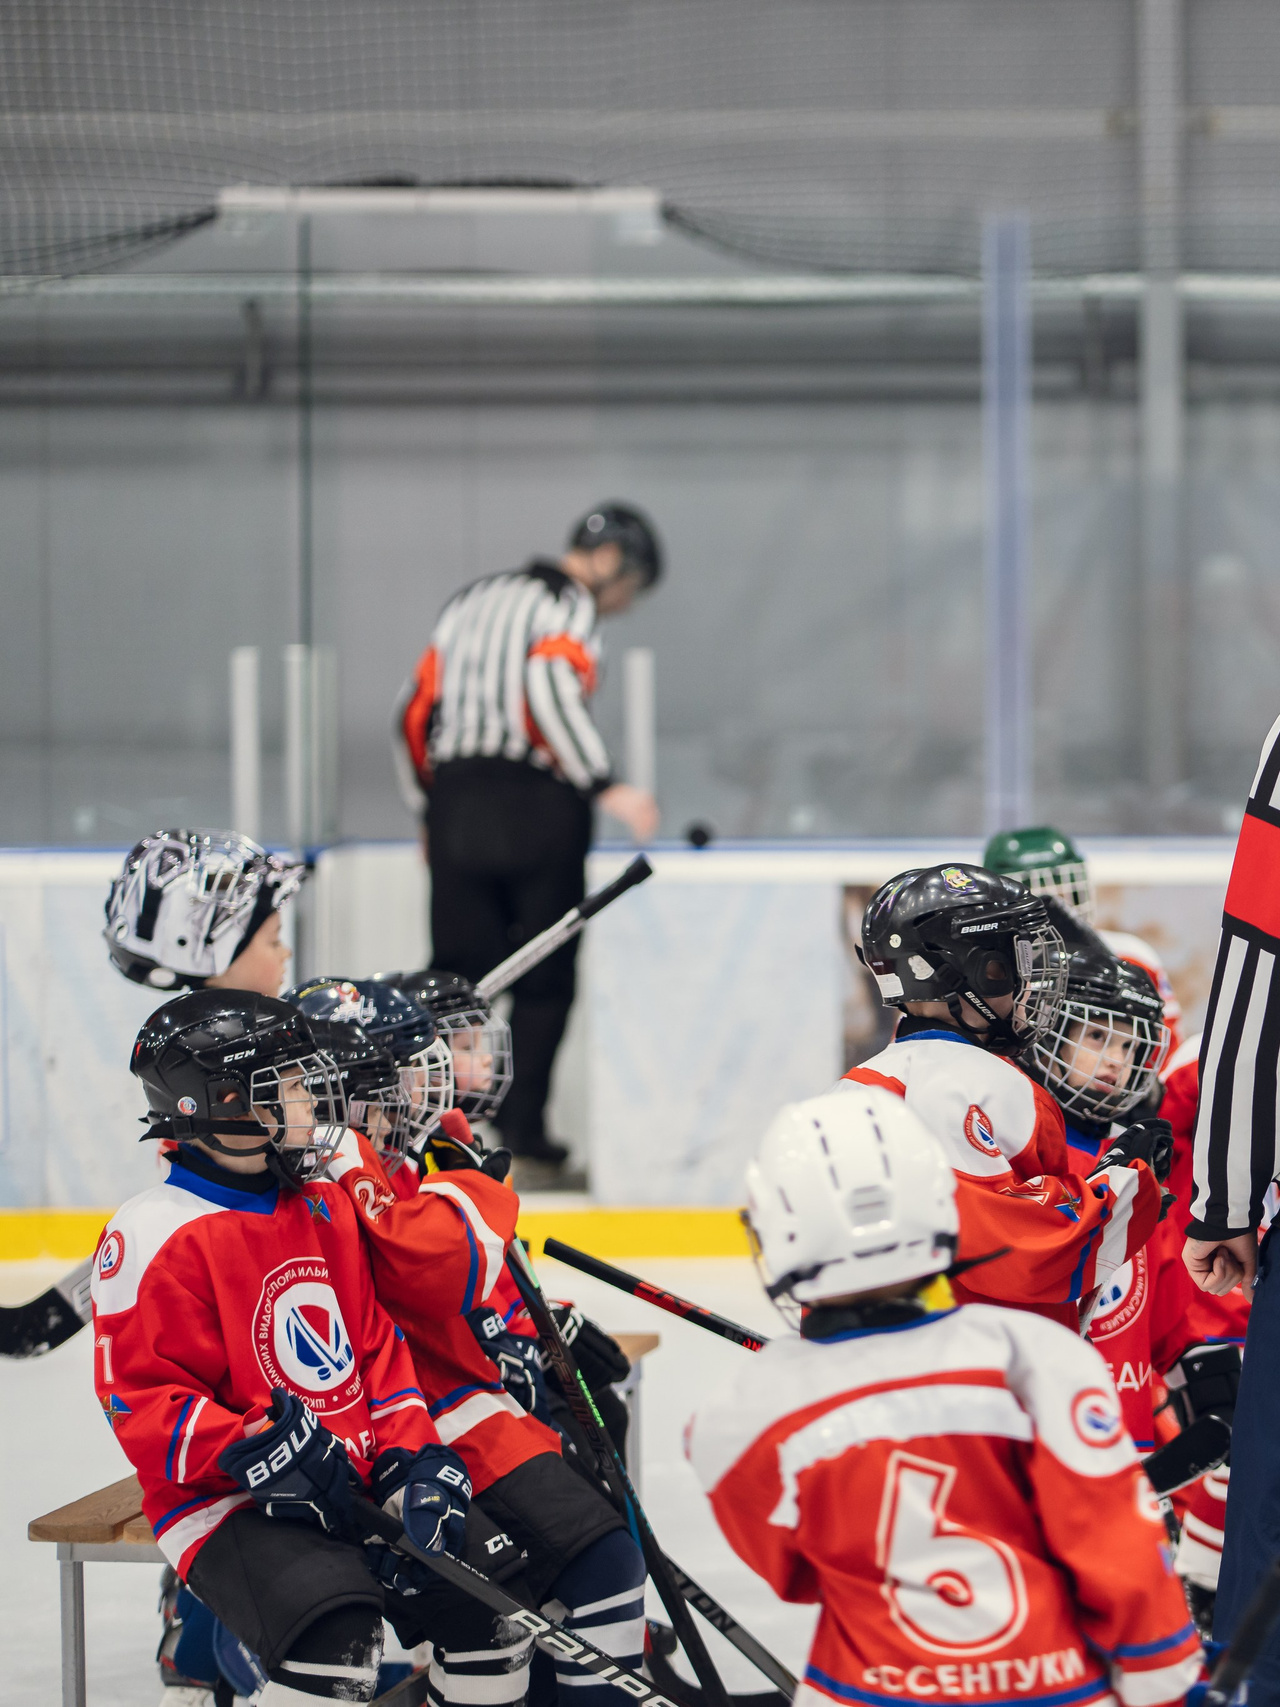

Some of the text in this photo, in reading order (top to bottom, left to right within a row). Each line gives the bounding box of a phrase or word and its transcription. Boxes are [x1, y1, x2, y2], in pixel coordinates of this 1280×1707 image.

[960, 922, 999, 934] BAUER
[964, 991, 998, 1020] BAUER
[223, 1048, 256, 1063] CCM
[95, 1334, 115, 1384] 1
[875, 1449, 1029, 1658] 6
